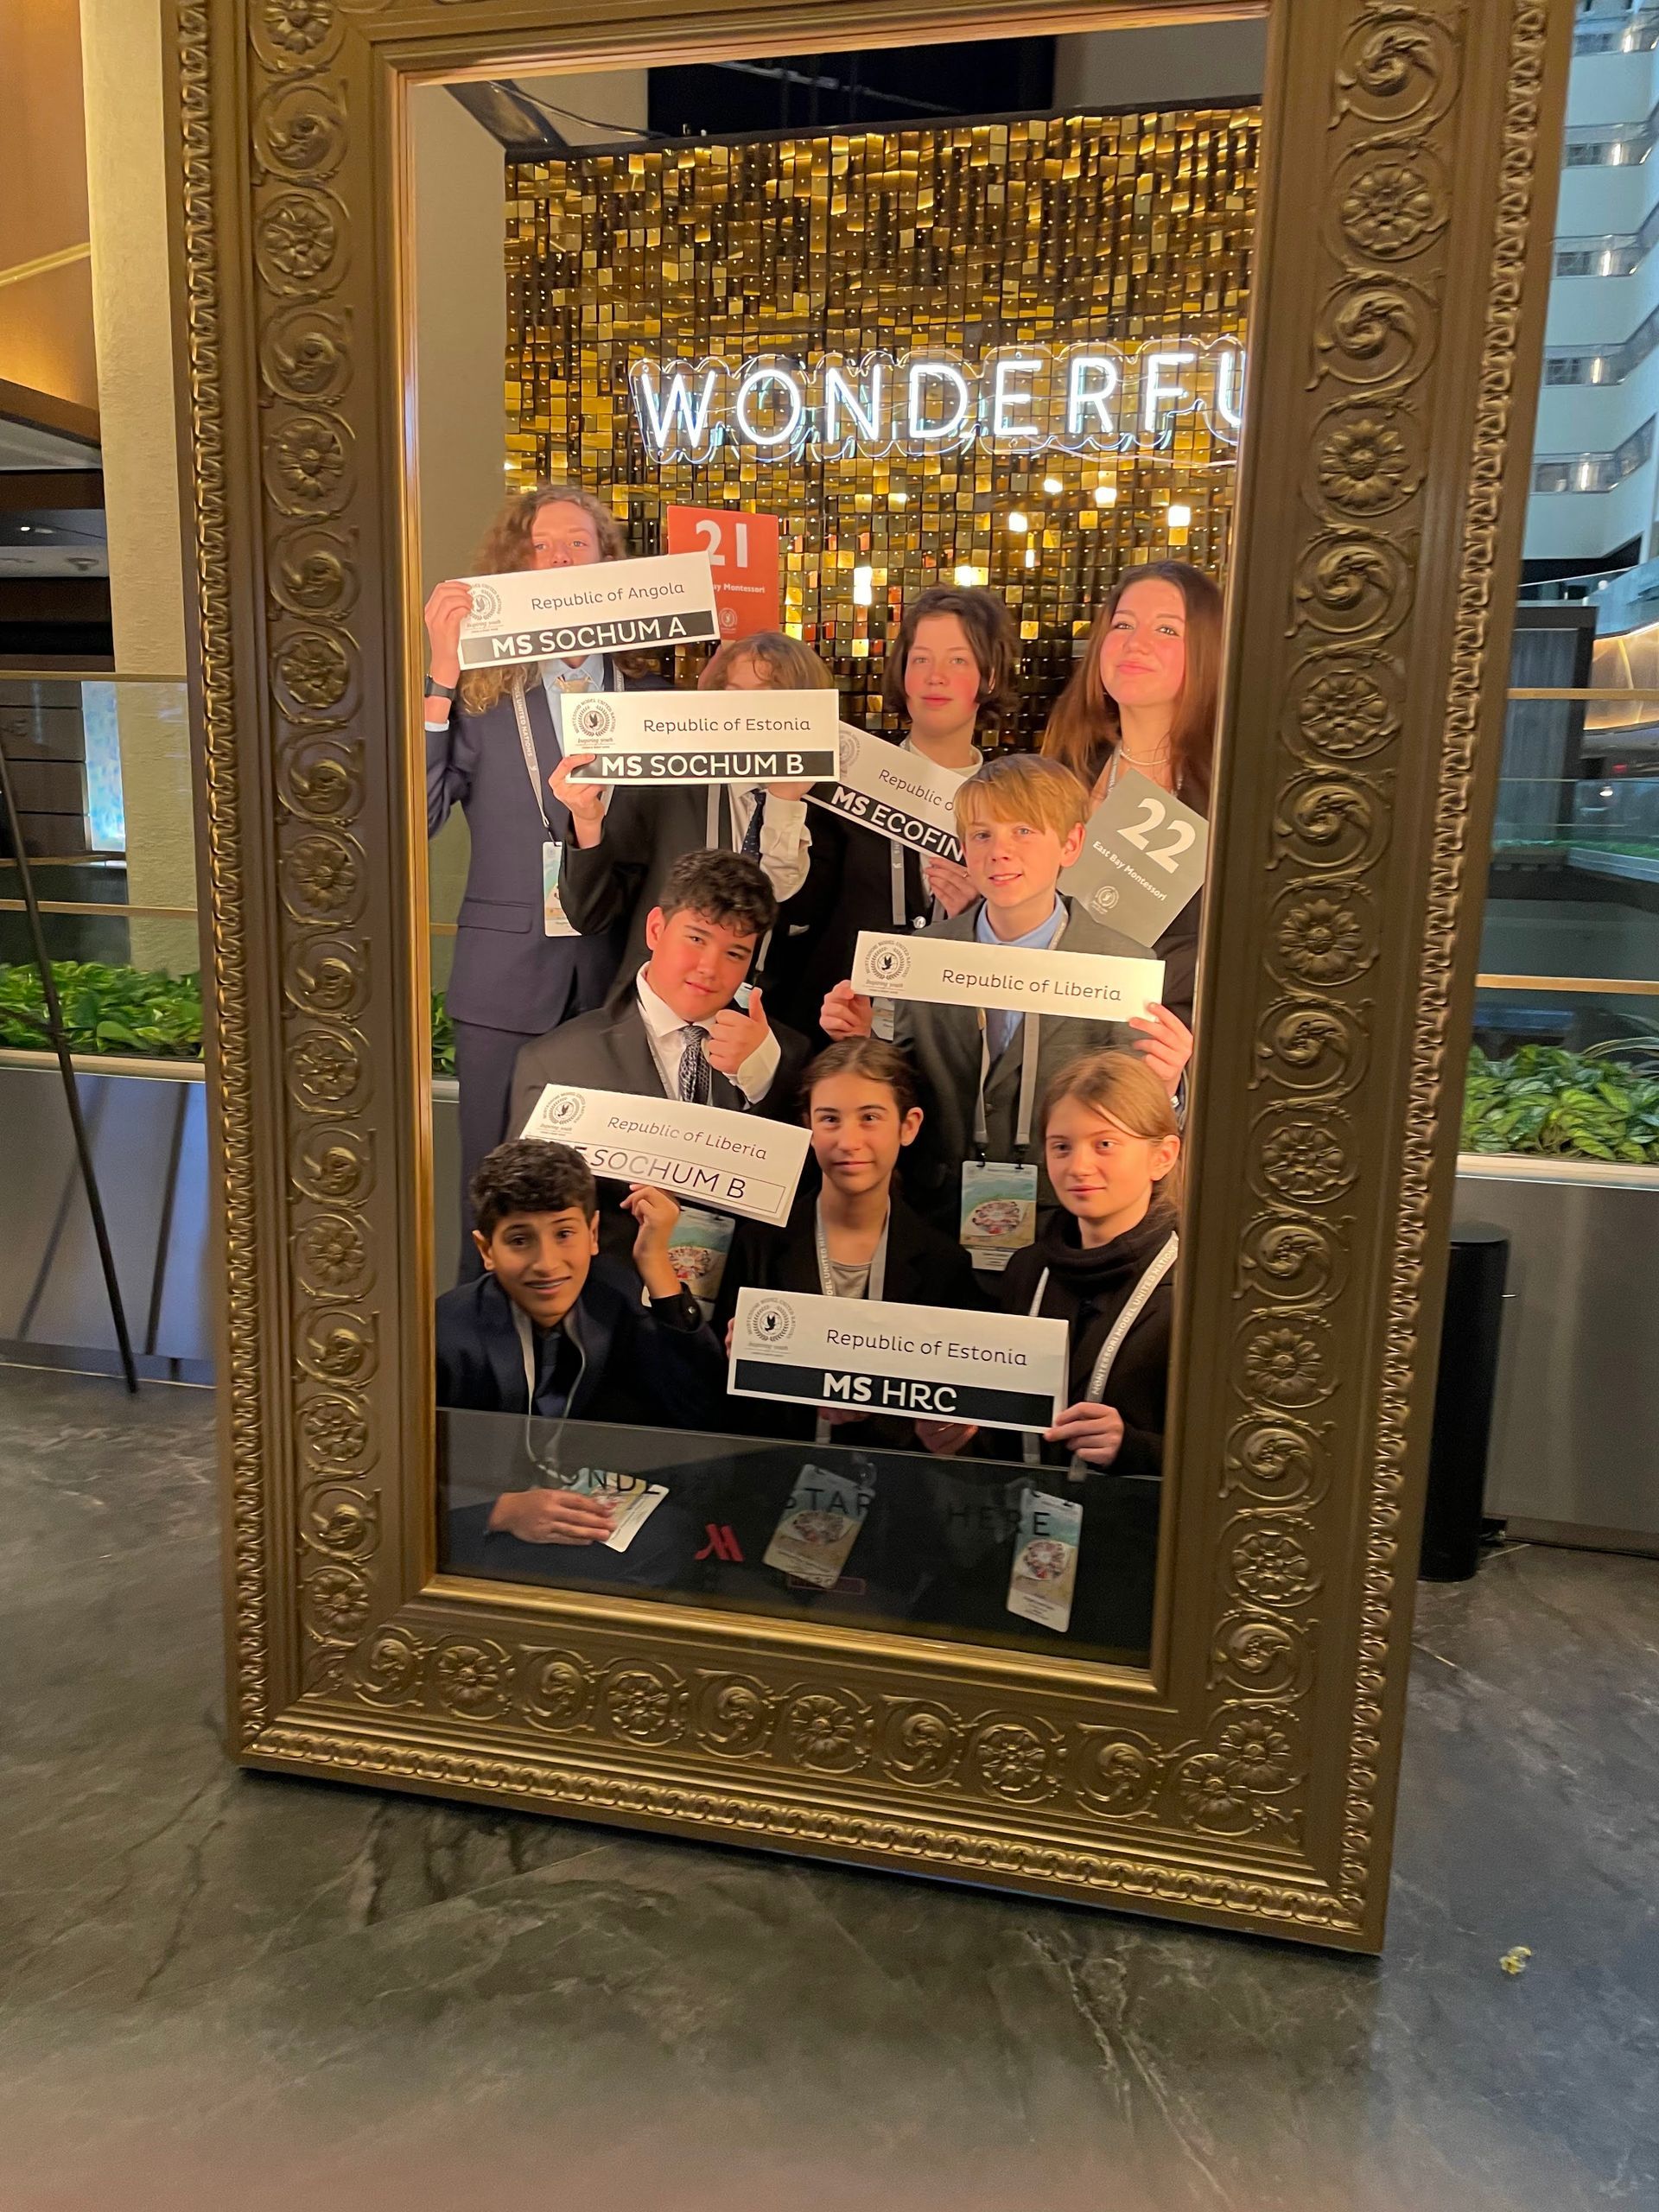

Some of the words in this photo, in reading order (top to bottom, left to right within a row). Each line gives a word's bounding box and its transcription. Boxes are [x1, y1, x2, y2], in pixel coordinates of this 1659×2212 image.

[696, 519, 748, 568] 21
[531, 591, 603, 611] Republic
[607, 588, 622, 601] of
[628, 582, 685, 601] Angola
[724, 583, 766, 594] Montessori
[492, 635, 533, 658] MS
[540, 619, 661, 652] SOCHUM
[669, 616, 688, 638] A
[644, 718, 719, 734] Republic
[723, 717, 741, 731] of
[746, 717, 811, 731] Estonia
[601, 755, 643, 777] MS
[650, 753, 777, 776] SOCHUM
[786, 753, 804, 775] B
[879, 768, 944, 807] Republic
[944, 801, 955, 811] o
[830, 785, 871, 817] MS
[870, 804, 964, 862] ECOFIN
[1116, 798, 1196, 874] 22
[1092, 840, 1111, 858] East
[1109, 852, 1126, 870] Bay
[1123, 864, 1168, 902] Montessori
[942, 969, 1026, 991] Republic
[1029, 978, 1051, 993] of
[1053, 981, 1122, 1001] Liberia
[607, 1116, 682, 1141] Republic
[683, 1130, 704, 1143] of
[705, 1133, 768, 1161] Liberia
[590, 1148, 721, 1192] SOCHUM
[726, 1178, 747, 1200] B
[1115, 1305, 1138, 1338] MODEL
[1132, 1274, 1157, 1310] UNITED
[826, 1329, 915, 1353] Republic
[920, 1340, 943, 1356] of
[947, 1343, 1027, 1367] Estonia
[823, 1372, 873, 1402] MS
[881, 1379, 958, 1413] HRC
